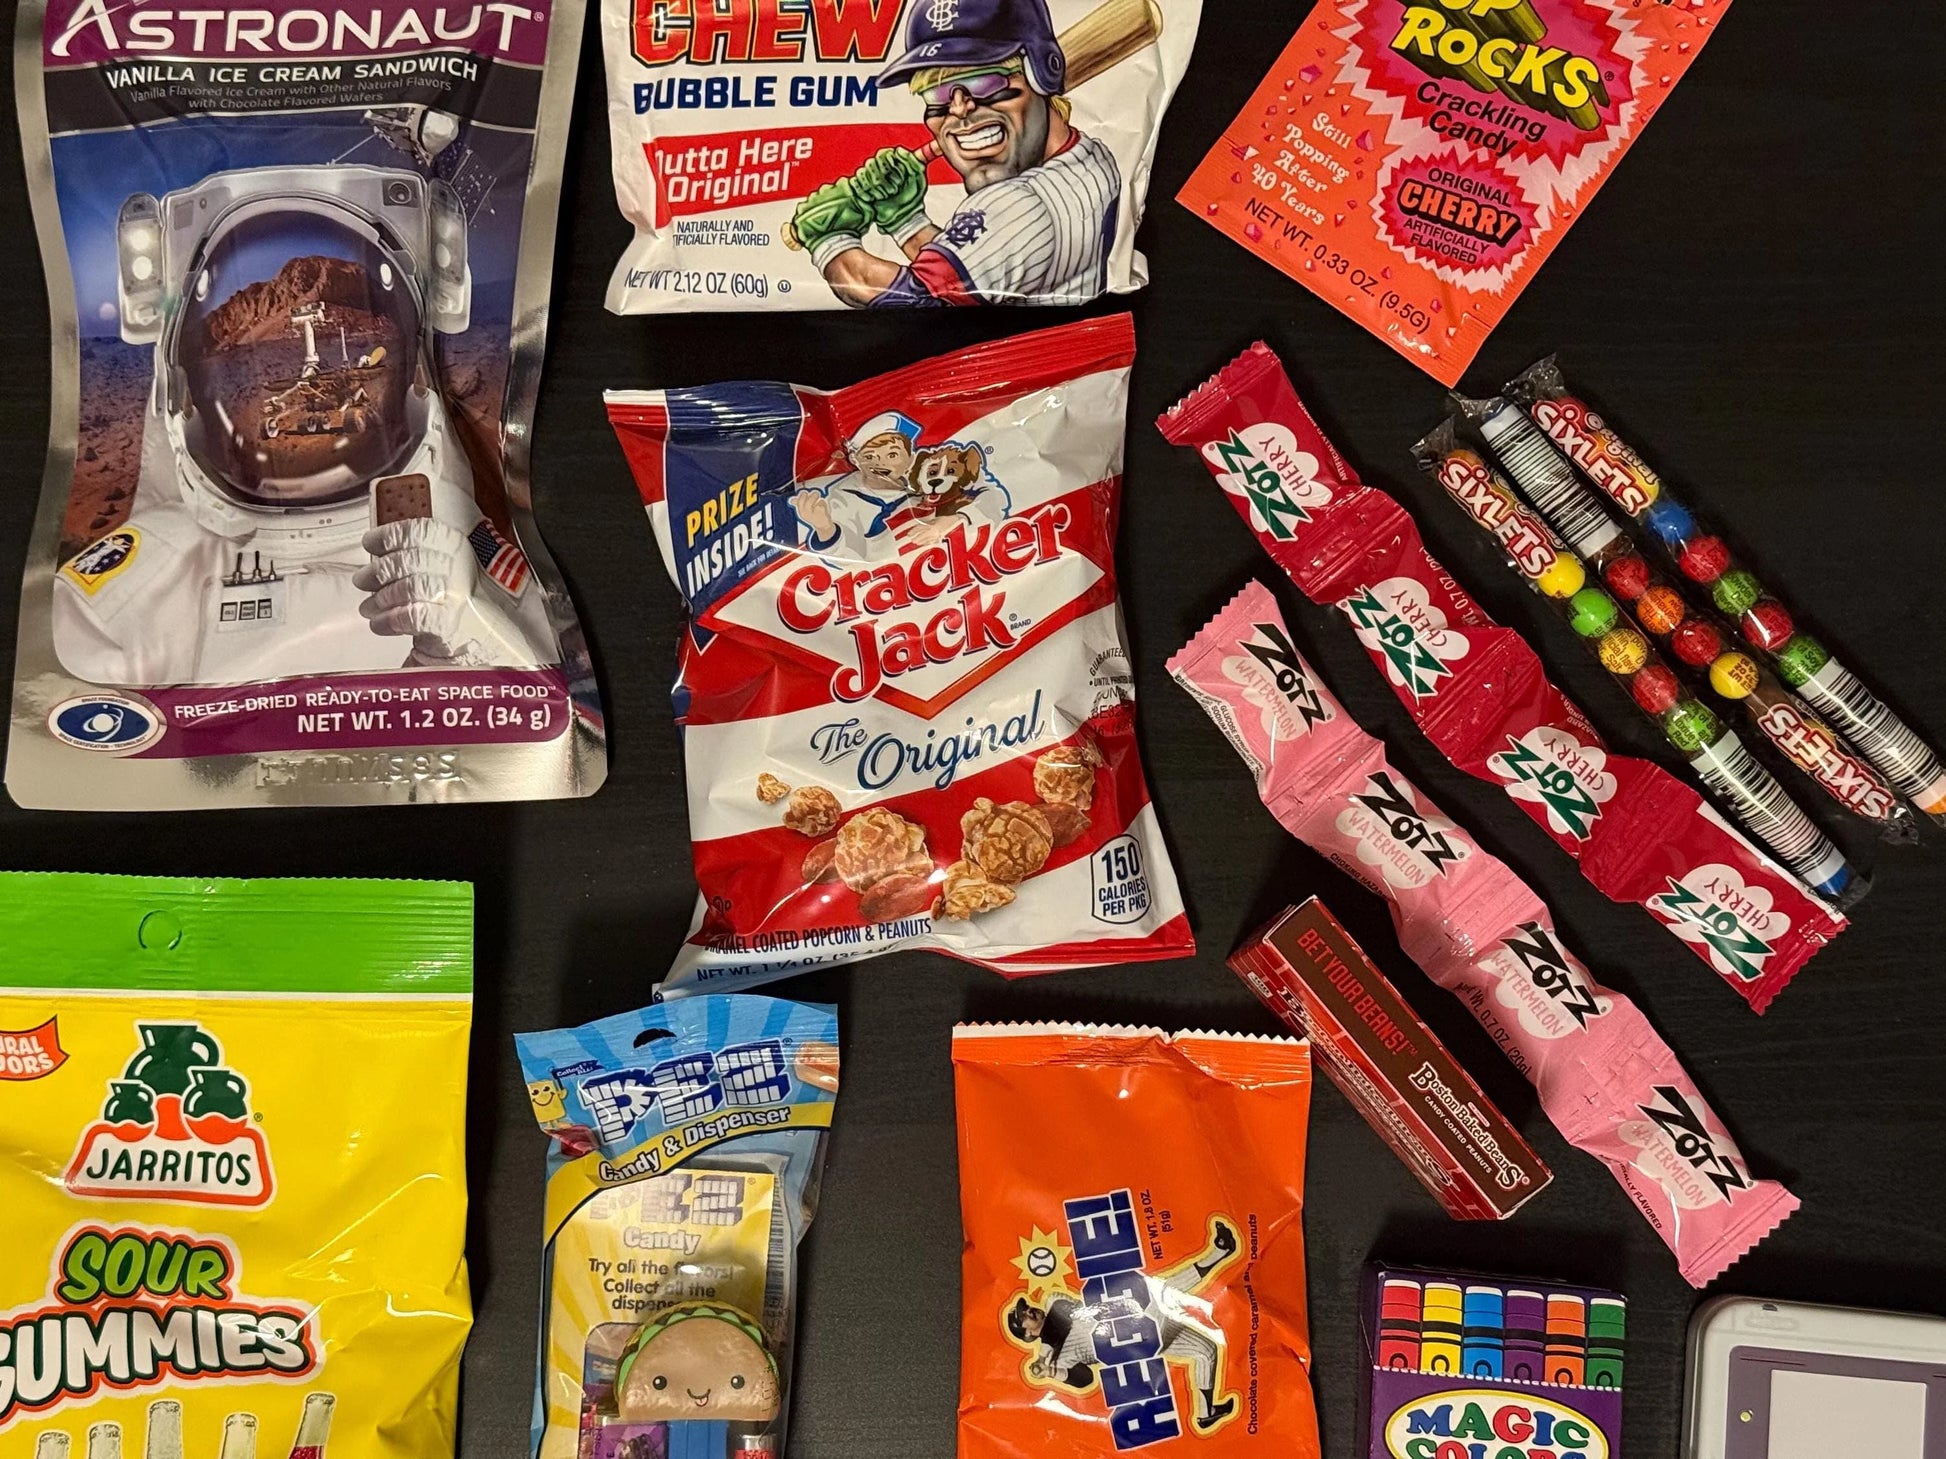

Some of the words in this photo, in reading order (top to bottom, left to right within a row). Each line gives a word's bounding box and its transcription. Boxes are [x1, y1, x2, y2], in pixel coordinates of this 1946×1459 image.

[51, 0, 532, 57] ASTRONAUT
[630, 0, 906, 68] CHEW
[919, 43, 942, 57] 16
[107, 67, 196, 89] VANILLA
[209, 68, 248, 82] ICE
[259, 66, 342, 82] CREAM
[354, 57, 477, 81] SANDWICH
[1390, 6, 1604, 112] ROCKS
[131, 87, 166, 103] Vanilla
[169, 85, 223, 98] Flavored
[226, 86, 243, 97] Ice
[247, 86, 286, 97] Cream
[289, 84, 316, 95] with
[320, 83, 353, 94] Other
[358, 79, 402, 91] Natural
[406, 77, 452, 91] Flavors
[189, 99, 217, 109] with
[220, 98, 281, 109] Chocolate
[284, 95, 335, 107] Flavored
[340, 92, 383, 103] Wafers
[634, 76, 778, 115] BUBBLE
[789, 75, 878, 107] GUM
[1416, 81, 1547, 143] Crackling
[739, 137, 813, 166] Here
[1282, 122, 1350, 185] Popping
[1311, 112, 1352, 149] Still
[1429, 110, 1518, 158] Candy
[668, 162, 790, 204] Original
[1251, 162, 1278, 191] 40
[1280, 181, 1326, 226] Years
[1273, 150, 1328, 194] After
[1427, 167, 1514, 208] ORIGINAL
[677, 220, 731, 234] NATURALLY
[733, 220, 754, 232] AND
[1397, 179, 1522, 248] CHERRY
[1403, 217, 1490, 255] ARTIFICIALLY
[719, 234, 770, 246] FLAVORED
[1410, 232, 1478, 265] FLAVORED
[624, 268, 651, 289] NET
[649, 270, 673, 290] WT
[674, 271, 700, 293] 2.12
[706, 272, 728, 294] OZ
[731, 274, 768, 297] (60g)
[1245, 197, 1284, 229] NET
[1282, 218, 1313, 252] WT.
[1313, 244, 1350, 276] 0.33
[1350, 269, 1379, 299] OZ.
[1379, 289, 1431, 334] (9.5G)
[1215, 427, 1312, 541] ZOTZ
[1259, 436, 1313, 497] CHERRY
[686, 472, 760, 549] PRIZE
[686, 502, 775, 600] INSIDE!
[776, 503, 1072, 633] Cracker
[1010, 618, 1032, 632] BRAND
[1347, 584, 1453, 697] ZOTZ
[1391, 590, 1448, 647] CHERRY
[830, 591, 1023, 704] Jack
[174, 694, 298, 719] FREEZE-DRIED
[306, 688, 431, 707] READY-TO-EAT
[438, 685, 493, 700] SPACE
[501, 685, 549, 698] FOOD
[1235, 659, 1297, 739] WATERMELON
[1237, 622, 1326, 736] ZOTZ
[298, 713, 344, 733] NET
[352, 710, 393, 731] WT.
[400, 709, 435, 729] 1.2
[443, 708, 480, 727] OZ.
[487, 705, 523, 729] (34
[530, 704, 551, 731] g)
[809, 717, 869, 765] The
[857, 689, 1045, 790] Original
[1544, 738, 1604, 790] CHERRY
[1498, 734, 1603, 842] ZOTZ
[1352, 770, 1459, 878] ZOTZ
[1101, 843, 1140, 884] 150
[1330, 852, 1364, 882] CHOKING
[1348, 811, 1425, 885] WATERMELON
[1099, 877, 1146, 902] CALORIES
[1103, 896, 1126, 917] PER
[1129, 892, 1146, 912] PKG
[1704, 877, 1770, 931] CHERRY
[753, 929, 799, 954] COATED
[804, 926, 861, 948] POPCORN
[865, 927, 875, 942] &
[879, 918, 932, 941] PEANUTS
[1657, 876, 1776, 983] ZOTZ
[1296, 928, 1330, 963] BET
[1325, 957, 1361, 1007] YOUR
[1354, 995, 1408, 1055] BEANS!
[1491, 953, 1564, 1035] WATERMELON
[1500, 920, 1601, 1033] ZOTZ
[1480, 1009, 1498, 1030] 0.7
[577, 1037, 792, 1143] PEZ
[599, 1149, 660, 1183] Candy
[664, 1136, 681, 1156] &
[685, 1107, 791, 1147] Dispenser
[1422, 1094, 1446, 1119] CANDY
[1441, 1117, 1468, 1145] COATED
[1464, 1142, 1493, 1174] PEANUTS
[1637, 1084, 1748, 1205] ZOTZ
[87, 1148, 251, 1185] JARRITOS
[1631, 1124, 1708, 1206] WATERMELON
[1139, 1189, 1151, 1205] OZ.
[1143, 1206, 1154, 1219] 1.8
[1158, 1209, 1172, 1232] (51g)
[1634, 1191, 1663, 1229] FLAVORED
[624, 1226, 702, 1255] Candy
[1146, 1221, 1158, 1239] WT.
[1151, 1241, 1163, 1259] NET
[1247, 1214, 1257, 1259] peanuts
[58, 1230, 228, 1304] SOUR
[588, 1258, 611, 1273] Try
[617, 1259, 636, 1272] all
[642, 1261, 667, 1275] the
[604, 1278, 660, 1294] Collect
[689, 1283, 716, 1298] the
[1063, 1187, 1183, 1452] REGGIE!
[1244, 1284, 1258, 1329] caramel
[1248, 1333, 1258, 1375] covered
[1247, 1379, 1258, 1434] Chocolate
[1407, 1402, 1590, 1448] MAGIC
